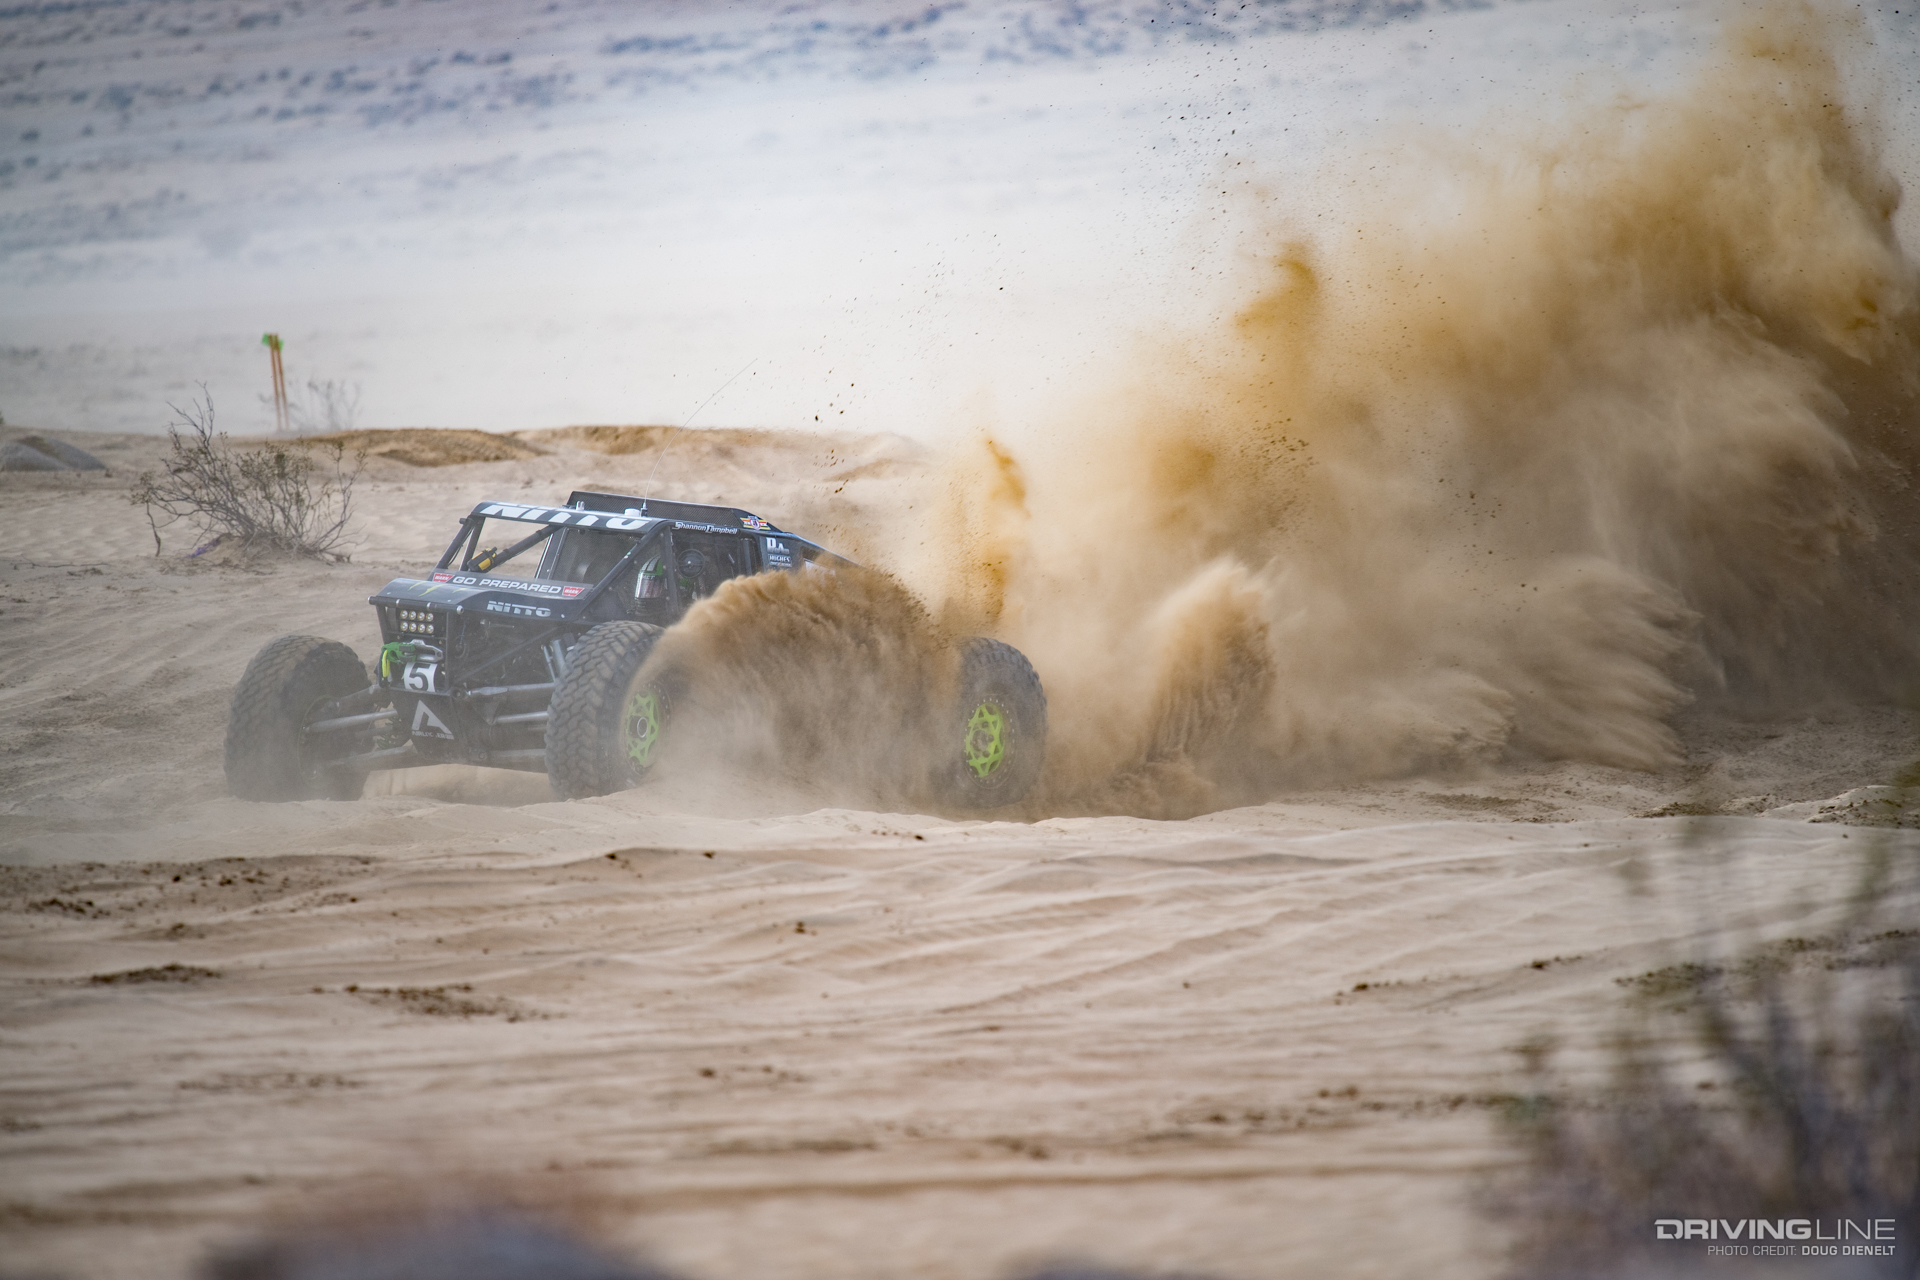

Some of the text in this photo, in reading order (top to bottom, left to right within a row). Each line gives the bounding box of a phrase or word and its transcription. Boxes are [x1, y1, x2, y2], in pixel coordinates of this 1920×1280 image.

[452, 576, 476, 584] GO
[478, 579, 561, 594] PREPARED
[487, 600, 551, 616] NITTO
[408, 664, 429, 691] 5
